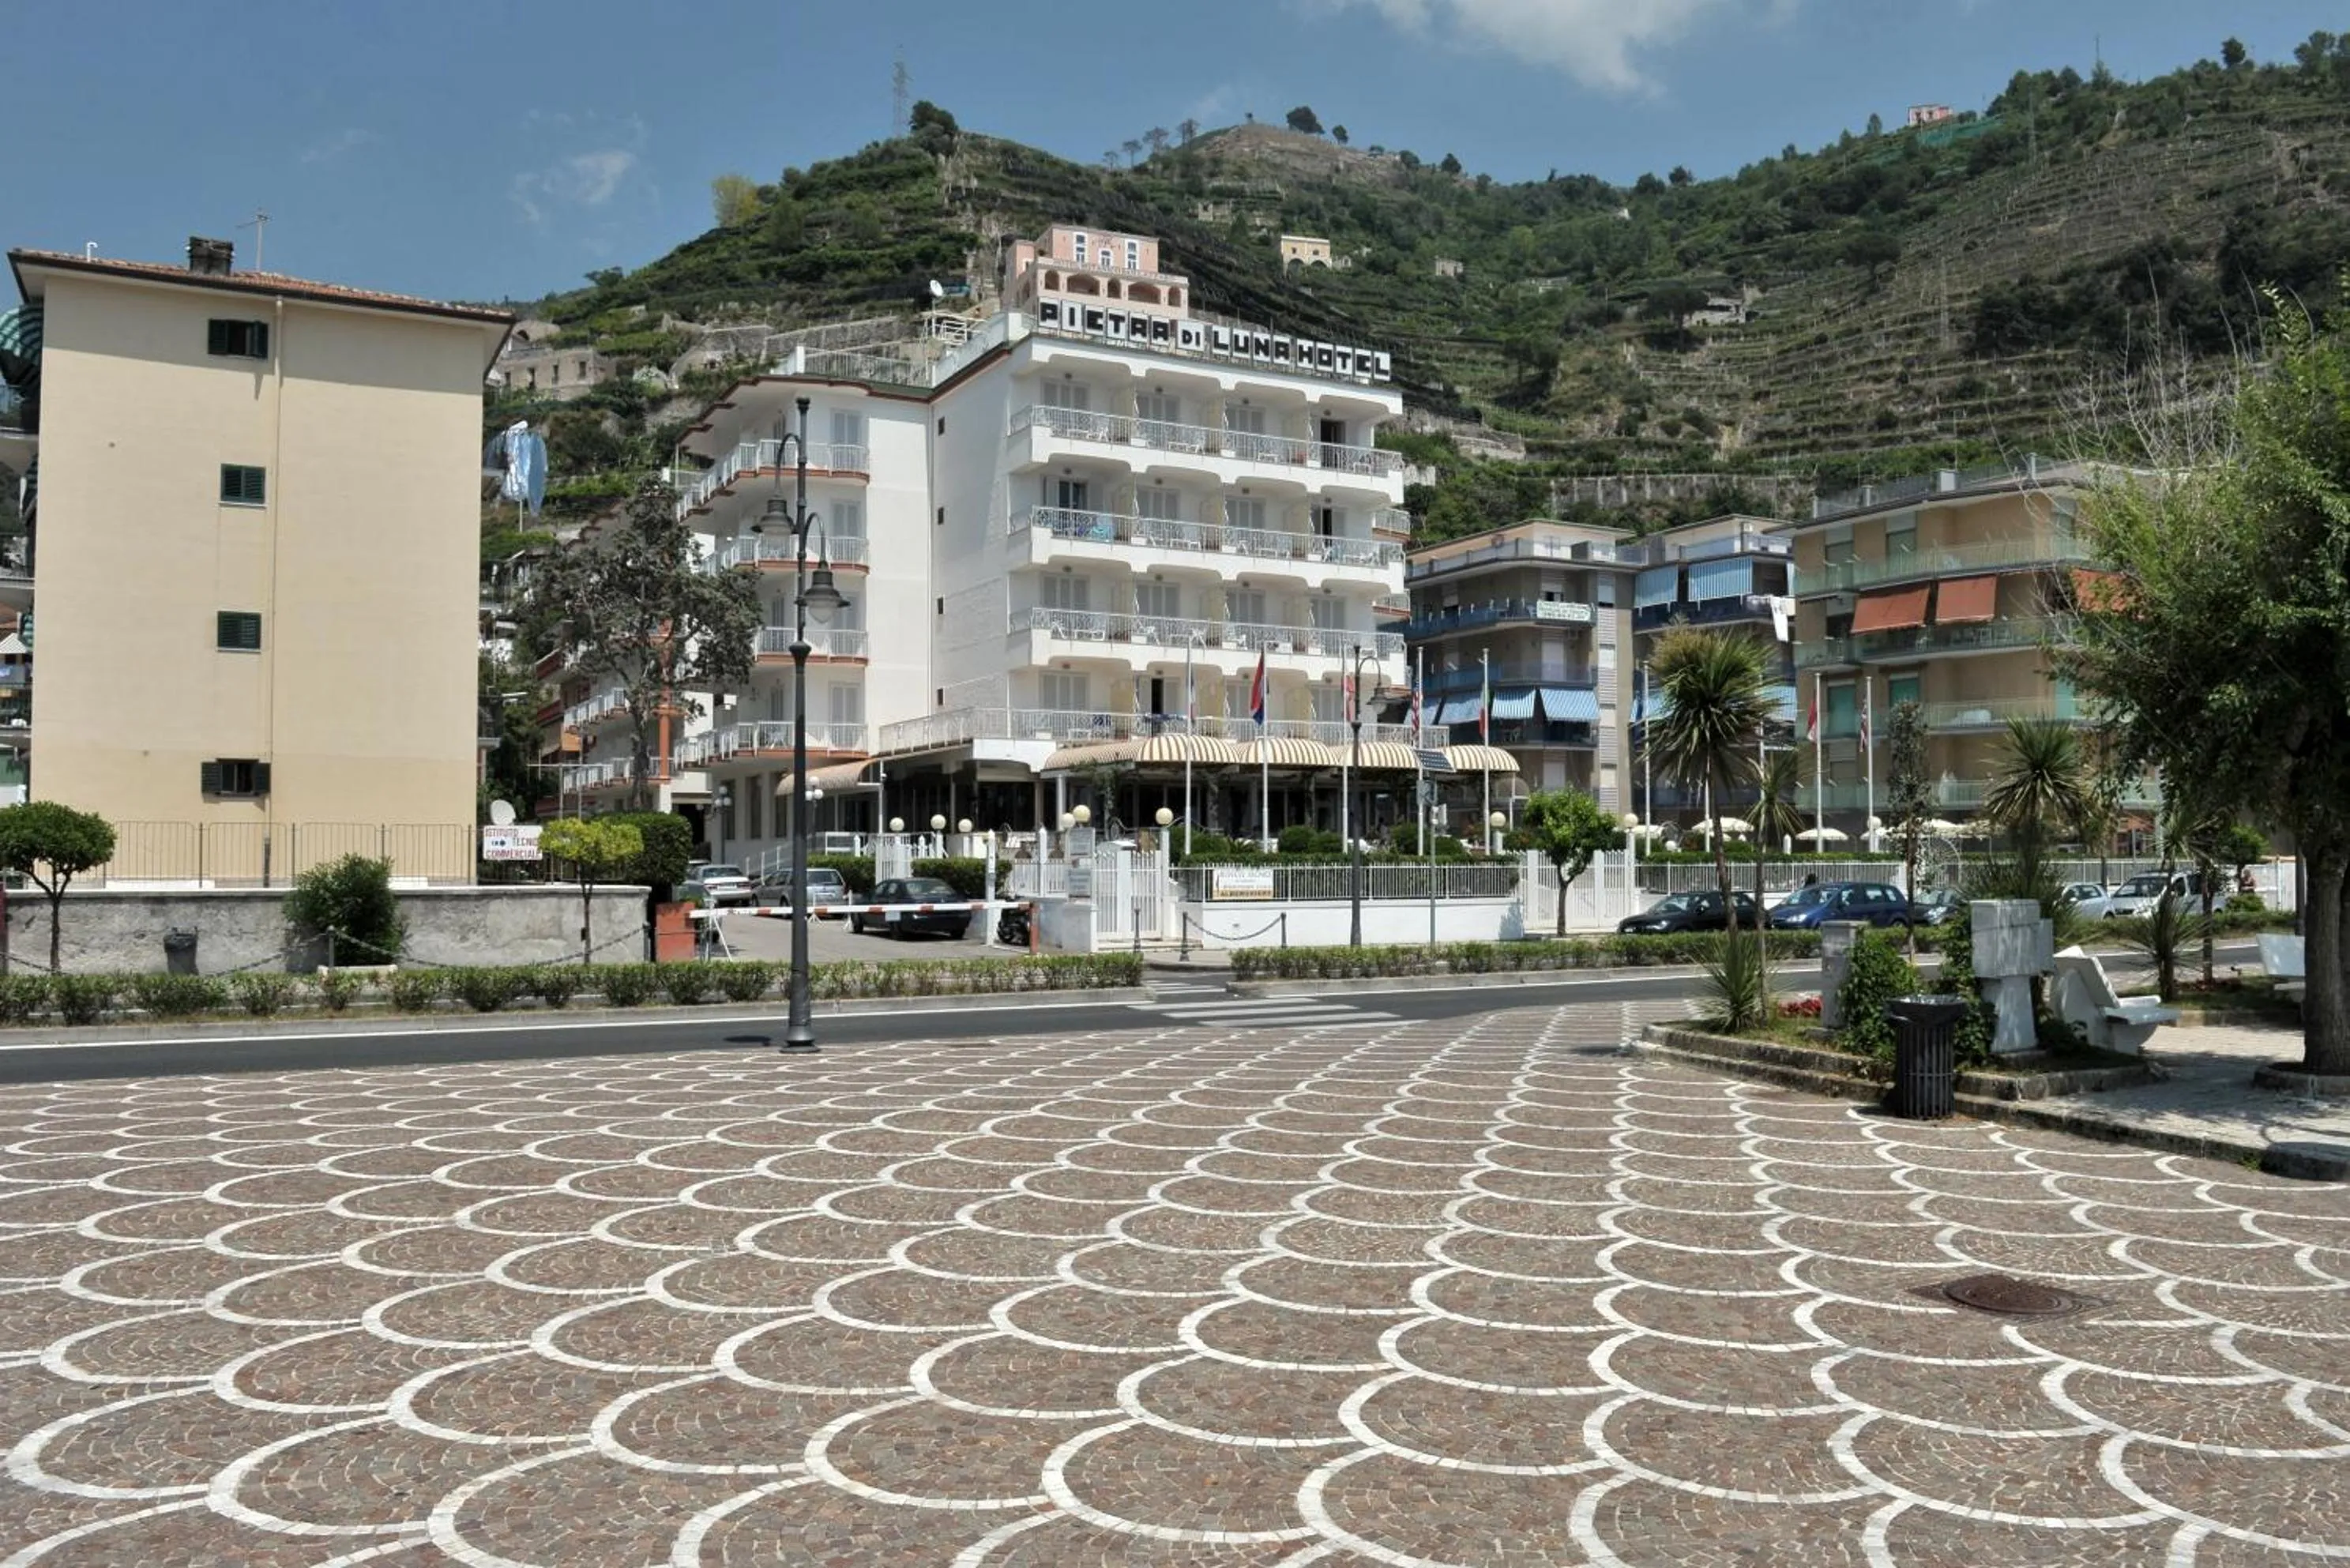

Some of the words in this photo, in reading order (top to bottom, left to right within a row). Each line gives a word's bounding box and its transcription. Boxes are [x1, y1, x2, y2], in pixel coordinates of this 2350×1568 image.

[1040, 302, 1169, 340] PIETRA
[1182, 329, 1201, 348] DI
[1213, 330, 1289, 360] LUNA
[1298, 344, 1389, 376] HOTEL
